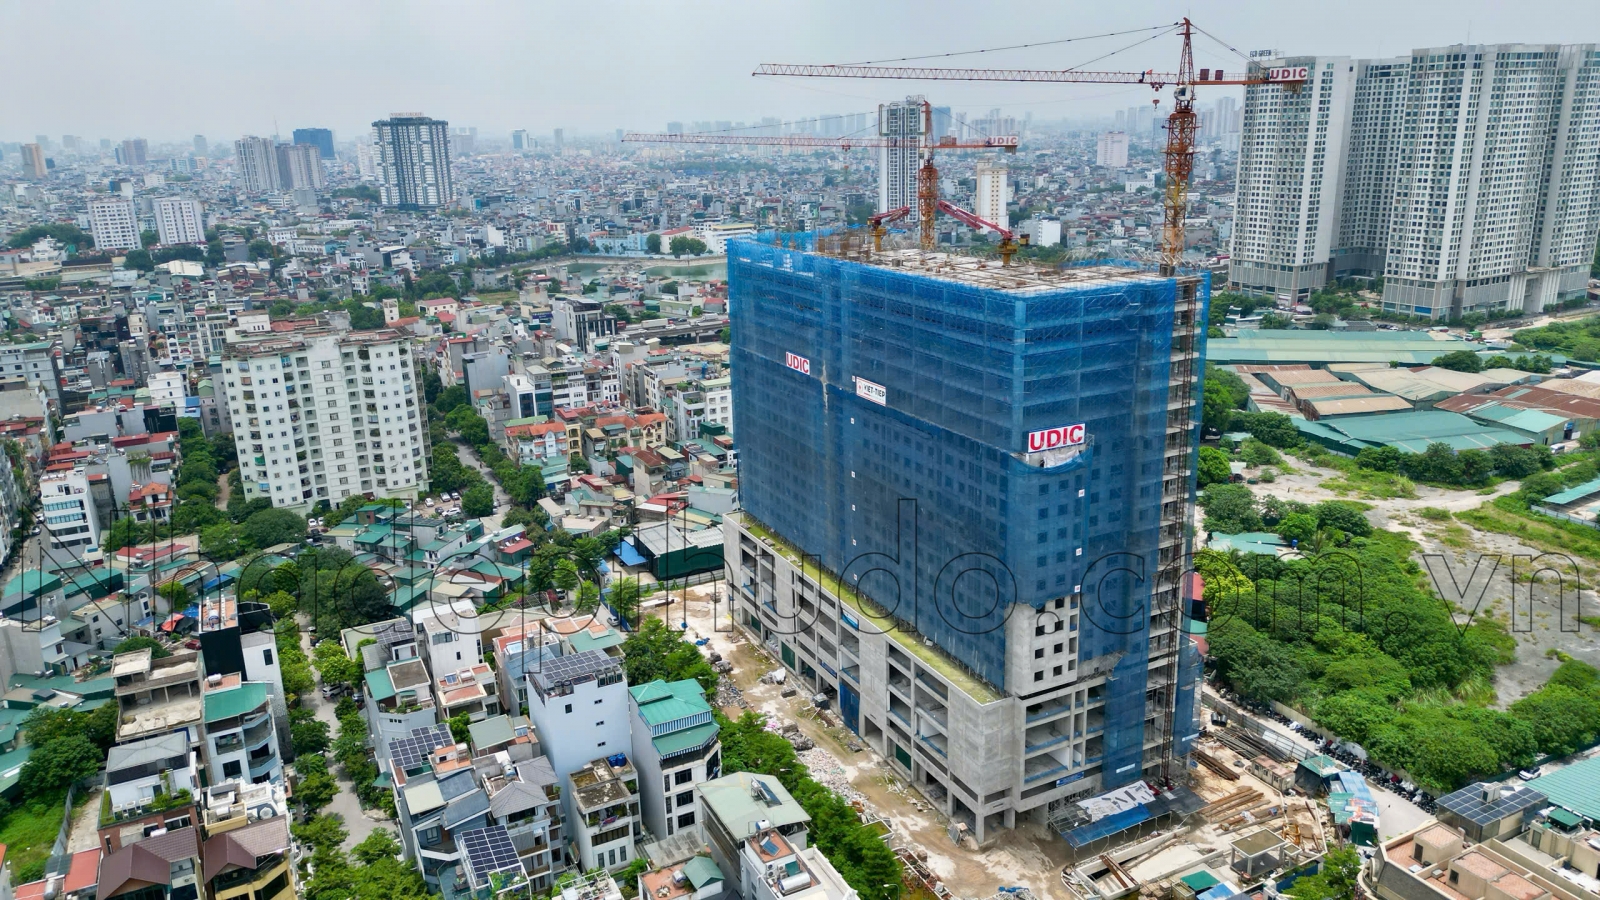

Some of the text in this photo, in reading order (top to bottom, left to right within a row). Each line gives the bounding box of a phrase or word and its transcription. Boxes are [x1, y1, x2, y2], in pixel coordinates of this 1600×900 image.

[1270, 68, 1308, 80] UDIC
[987, 136, 1018, 145] UDIC
[786, 353, 809, 374] UDIC
[1029, 425, 1084, 451] UDIC
